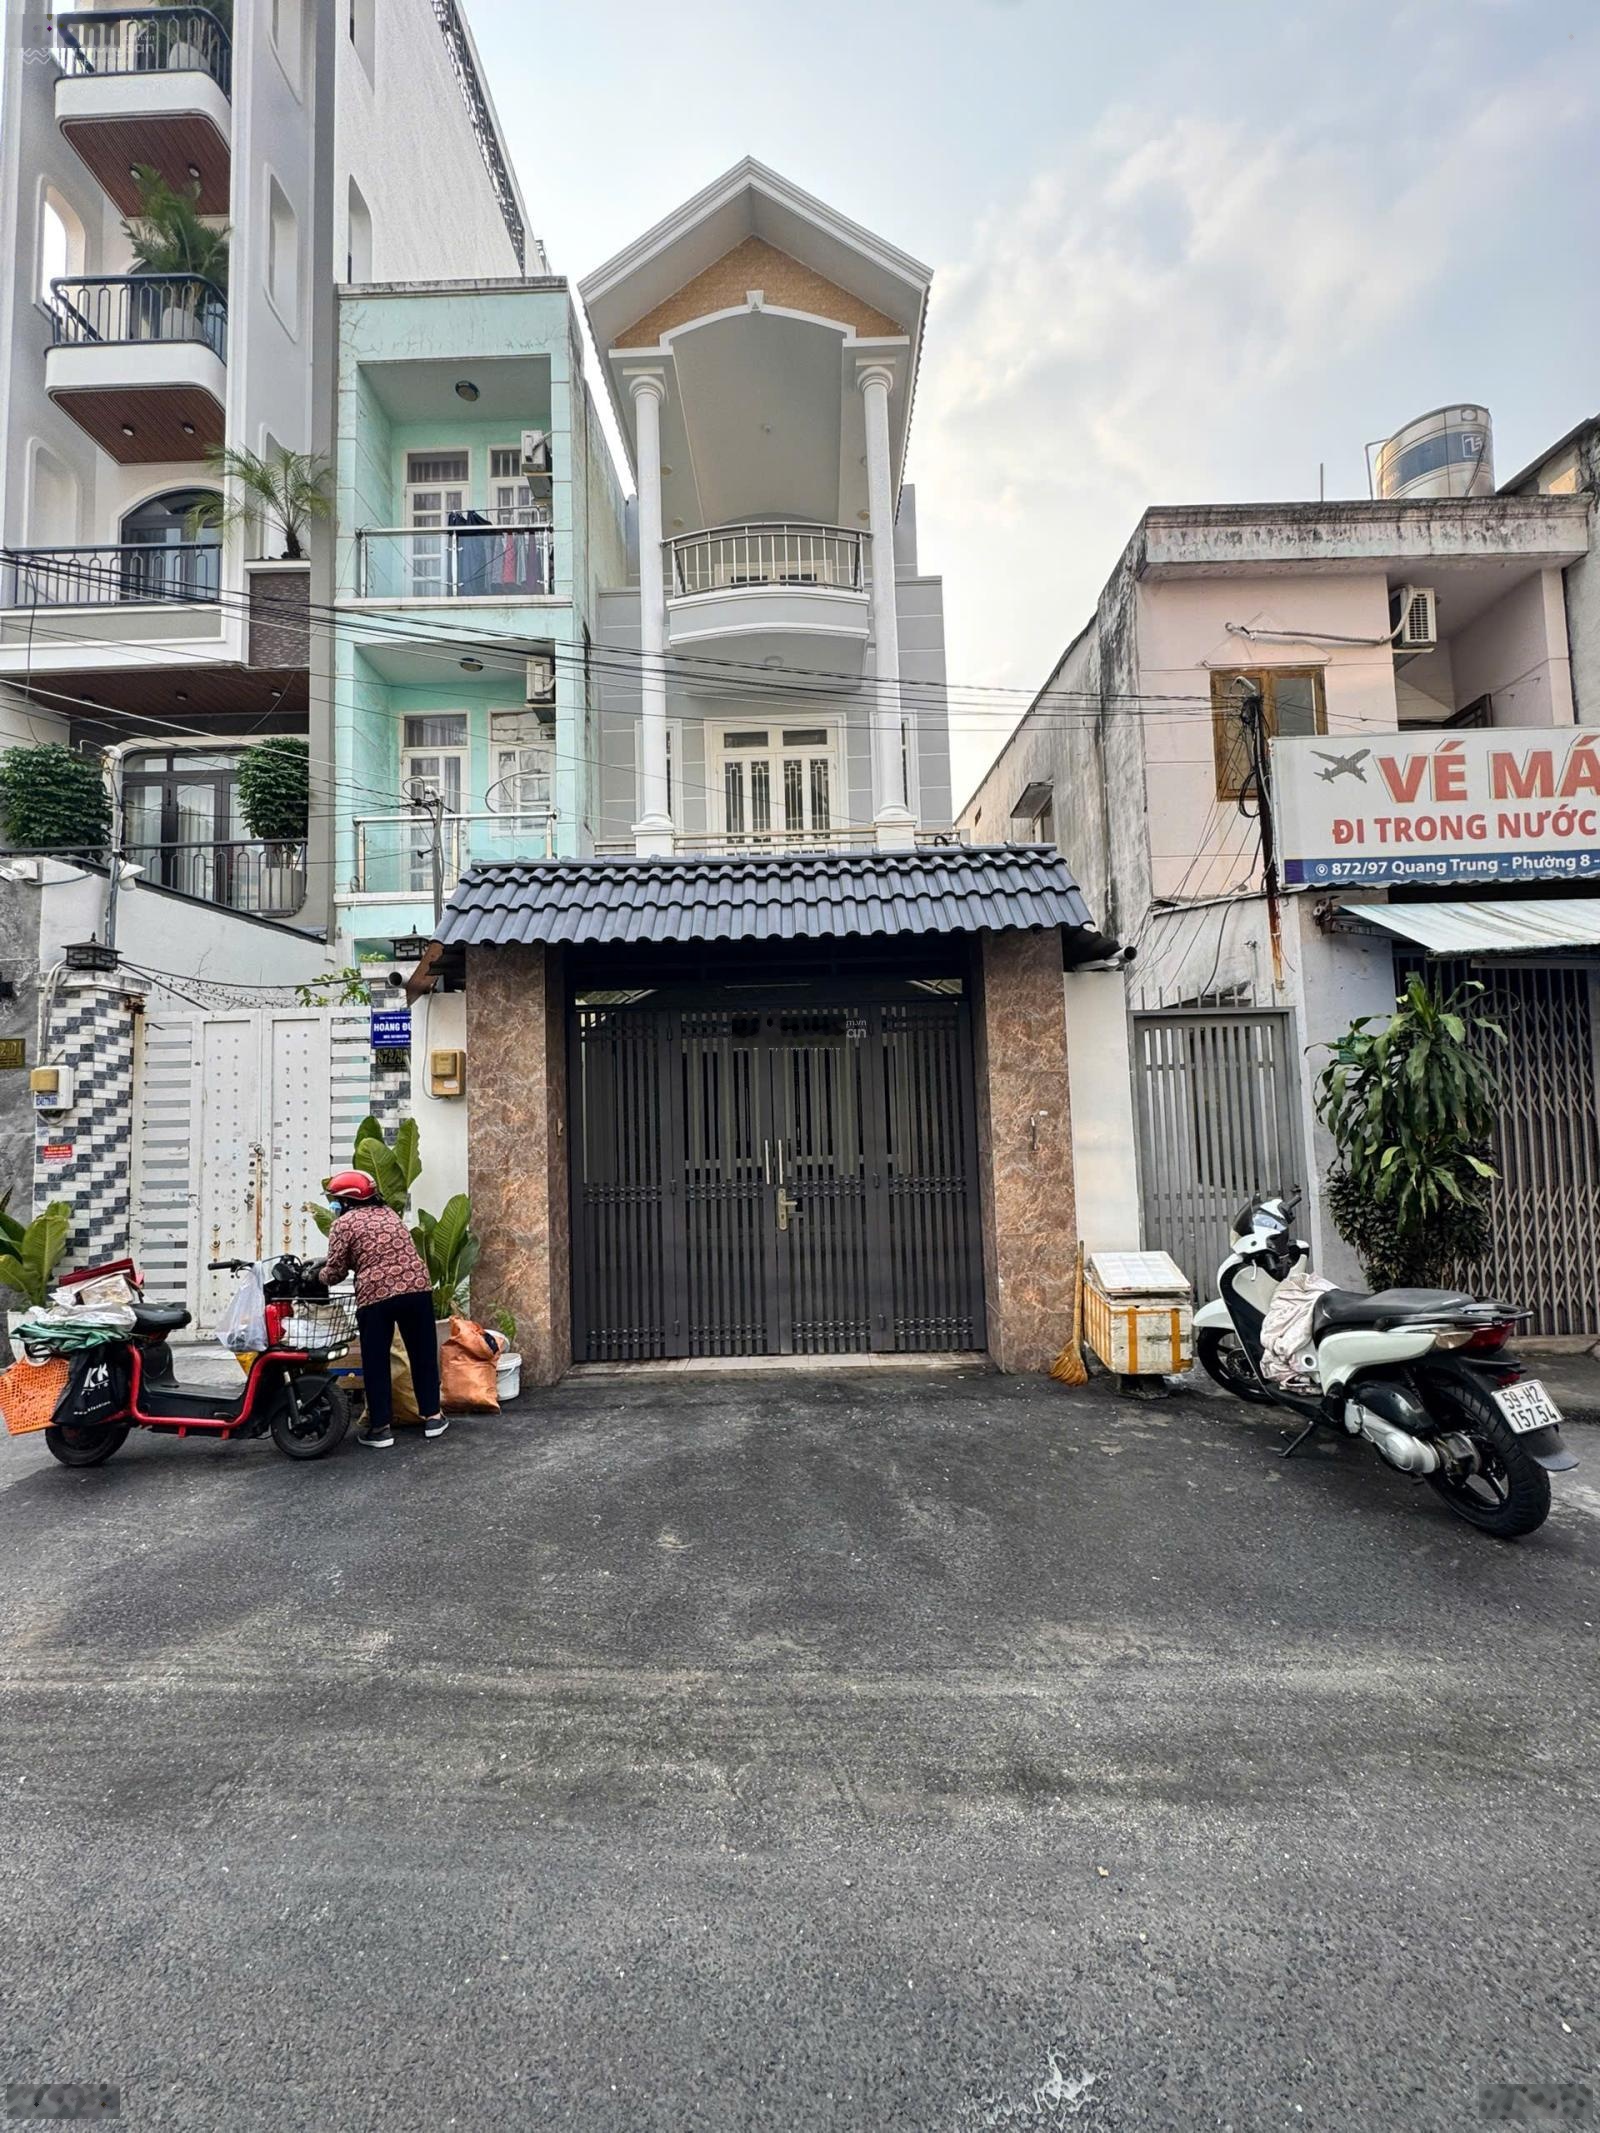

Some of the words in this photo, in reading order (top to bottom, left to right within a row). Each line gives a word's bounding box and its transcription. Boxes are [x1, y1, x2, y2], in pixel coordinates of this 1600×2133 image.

[1374, 737, 1468, 804] VÉ
[1331, 818, 1365, 844] ĐI
[1374, 813, 1488, 843] TRONG
[1498, 803, 1597, 839] NƯỚC
[1331, 861, 1388, 876] 872/97
[1391, 860, 1447, 876] Quang
[1449, 858, 1498, 873] Trung
[1512, 855, 1576, 871] Phường
[1580, 854, 1591, 867] 8
[373, 1021, 400, 1032] HOÀNG
[1501, 1385, 1543, 1410] 59-H2
[1510, 1404, 1558, 1430] 157.54
